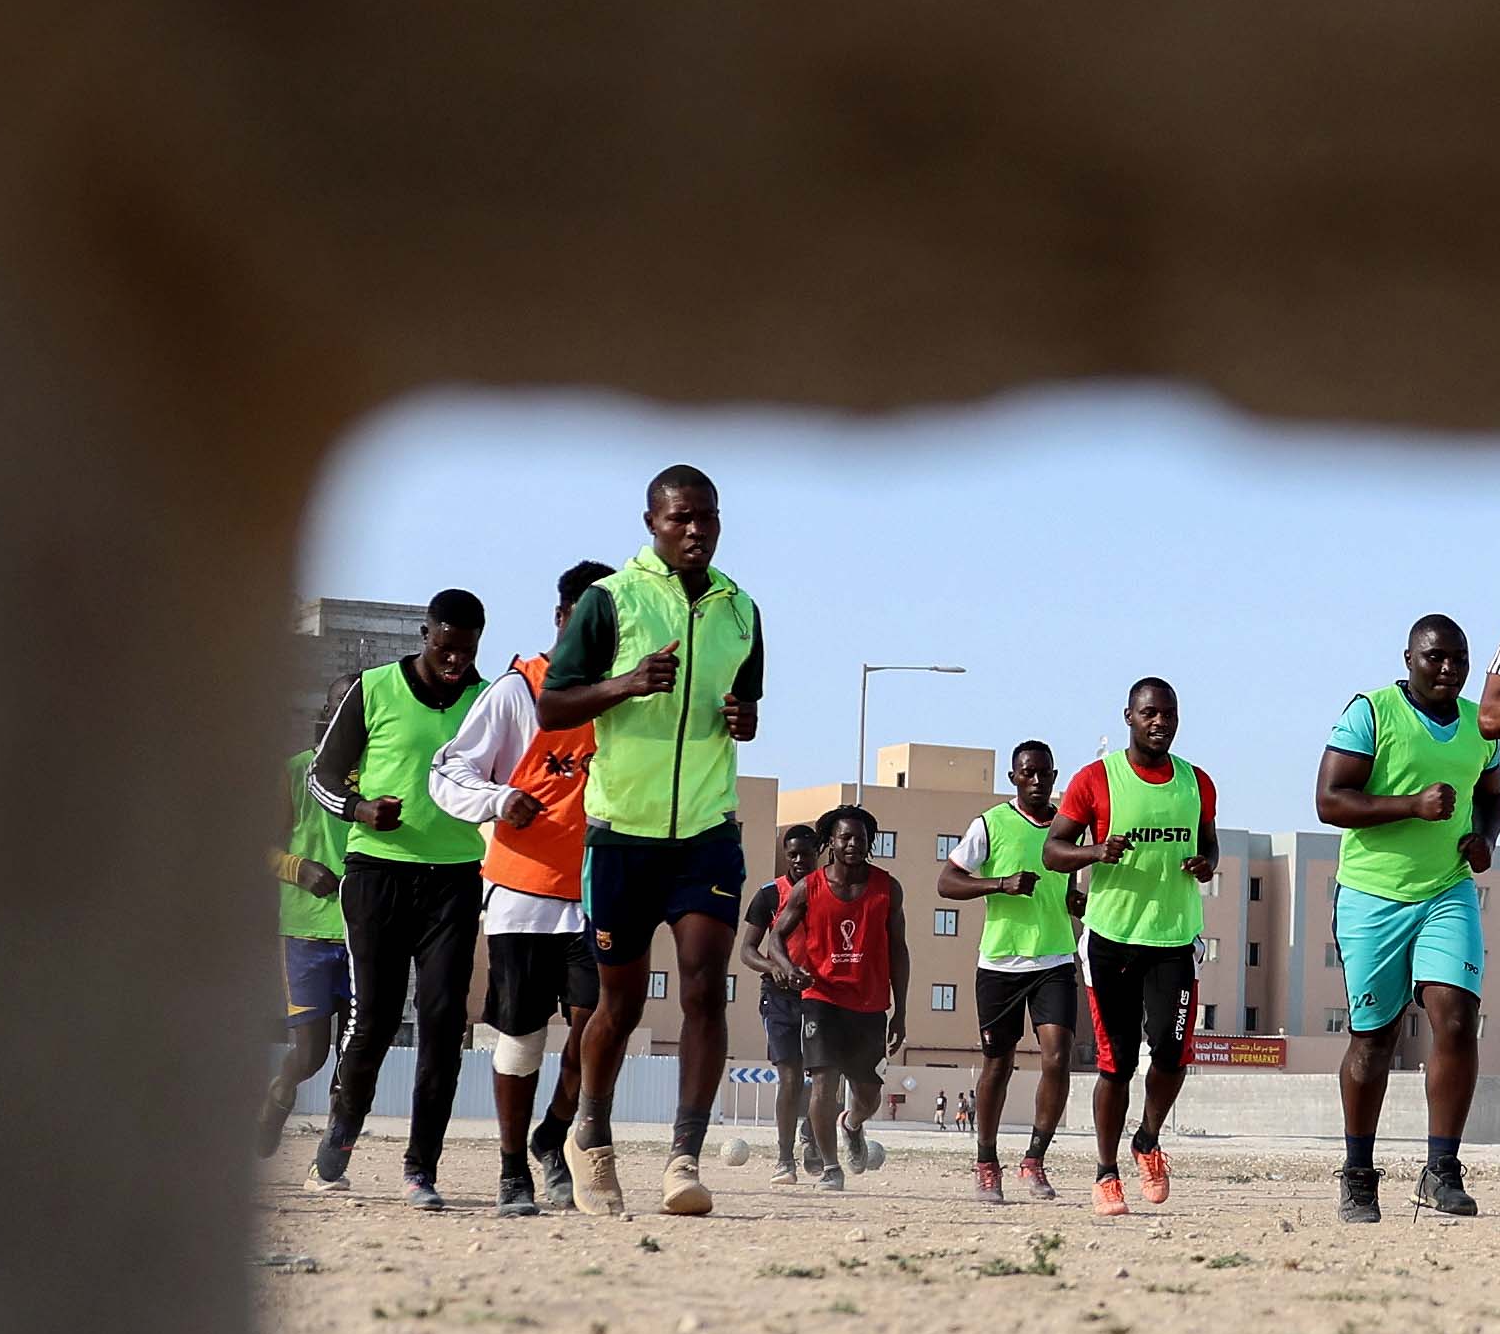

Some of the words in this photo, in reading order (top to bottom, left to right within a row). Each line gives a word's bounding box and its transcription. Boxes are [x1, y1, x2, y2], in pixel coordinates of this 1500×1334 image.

[1352, 993, 1376, 1008] 22
[1195, 1053, 1211, 1062] NEW
[1211, 1053, 1229, 1063] STAR
[1231, 1054, 1279, 1064] SUPERMARKET
